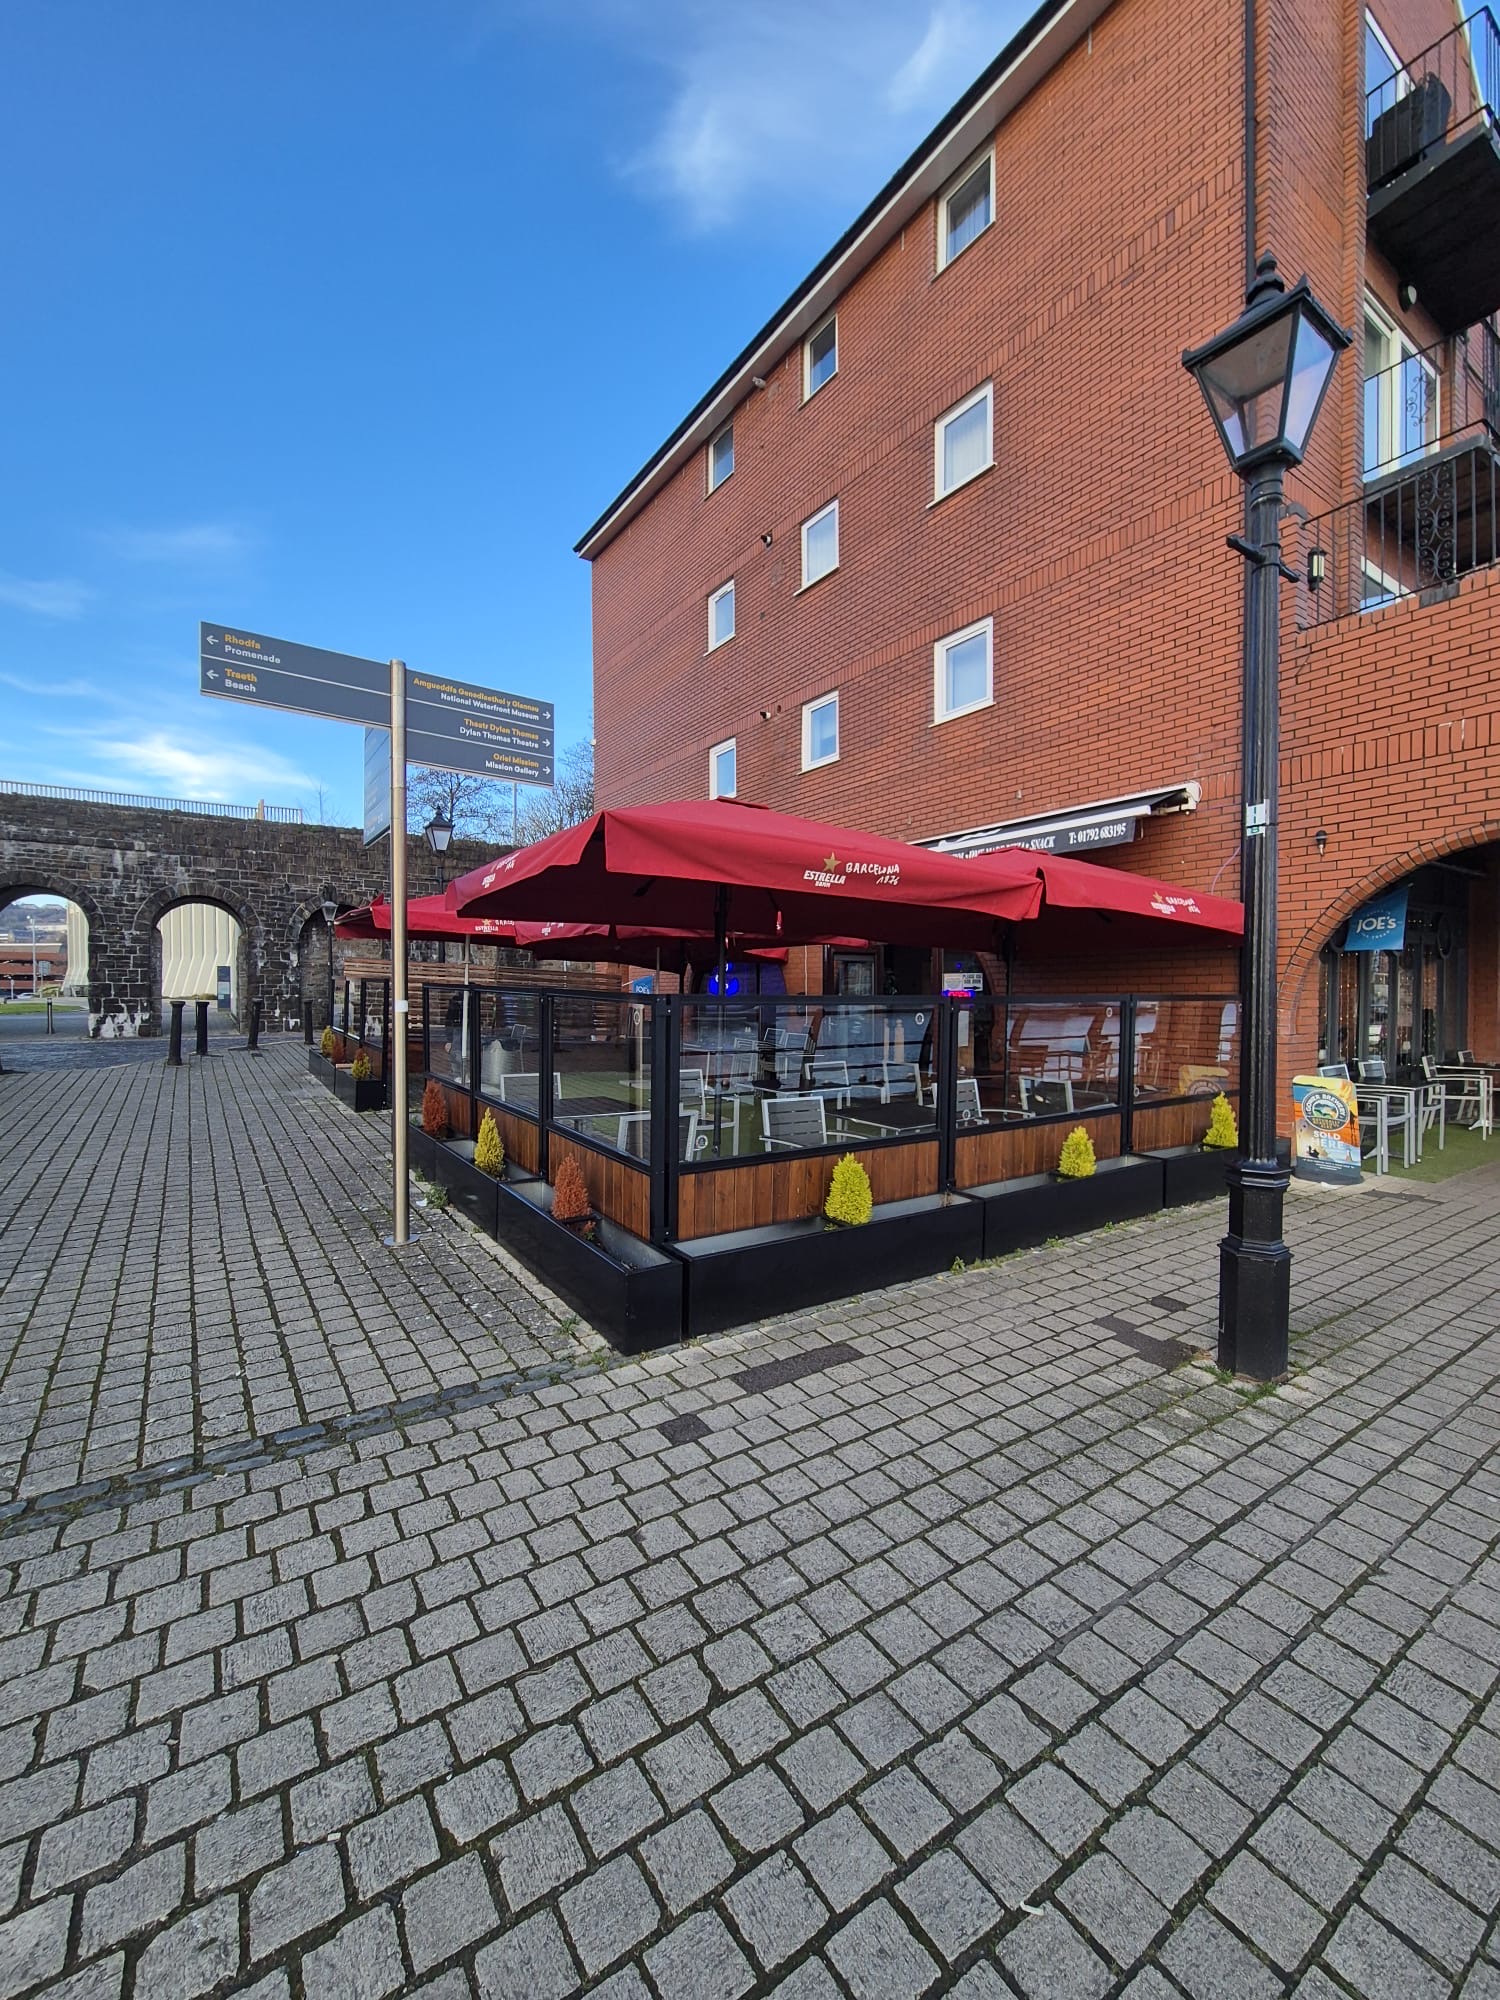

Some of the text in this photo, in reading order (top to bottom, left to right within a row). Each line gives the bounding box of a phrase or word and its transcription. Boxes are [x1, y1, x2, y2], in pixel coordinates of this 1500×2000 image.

[224, 634, 261, 649] Rhodfa
[225, 645, 281, 664] Promenade
[225, 668, 258, 683] Traeth
[225, 678, 256, 693] Beach
[413, 677, 539, 713] Amgueddfa Genedlaethol y Glannau
[440, 692, 539, 721] National Waterfront Museum
[464, 718, 539, 740] Theatr Dylan Thomas
[460, 727, 539, 749] Dylan Thomas Theatre
[485, 760, 539, 777] Mission Gallery
[493, 753, 539, 768] Oriel Mission
[1077, 827, 1099, 843] 01792
[1099, 823, 1127, 840] 683195
[845, 862, 900, 875] BARCELONA
[803, 870, 846, 885] ESTRELLA
[1313, 1130, 1341, 1140] SOLD
